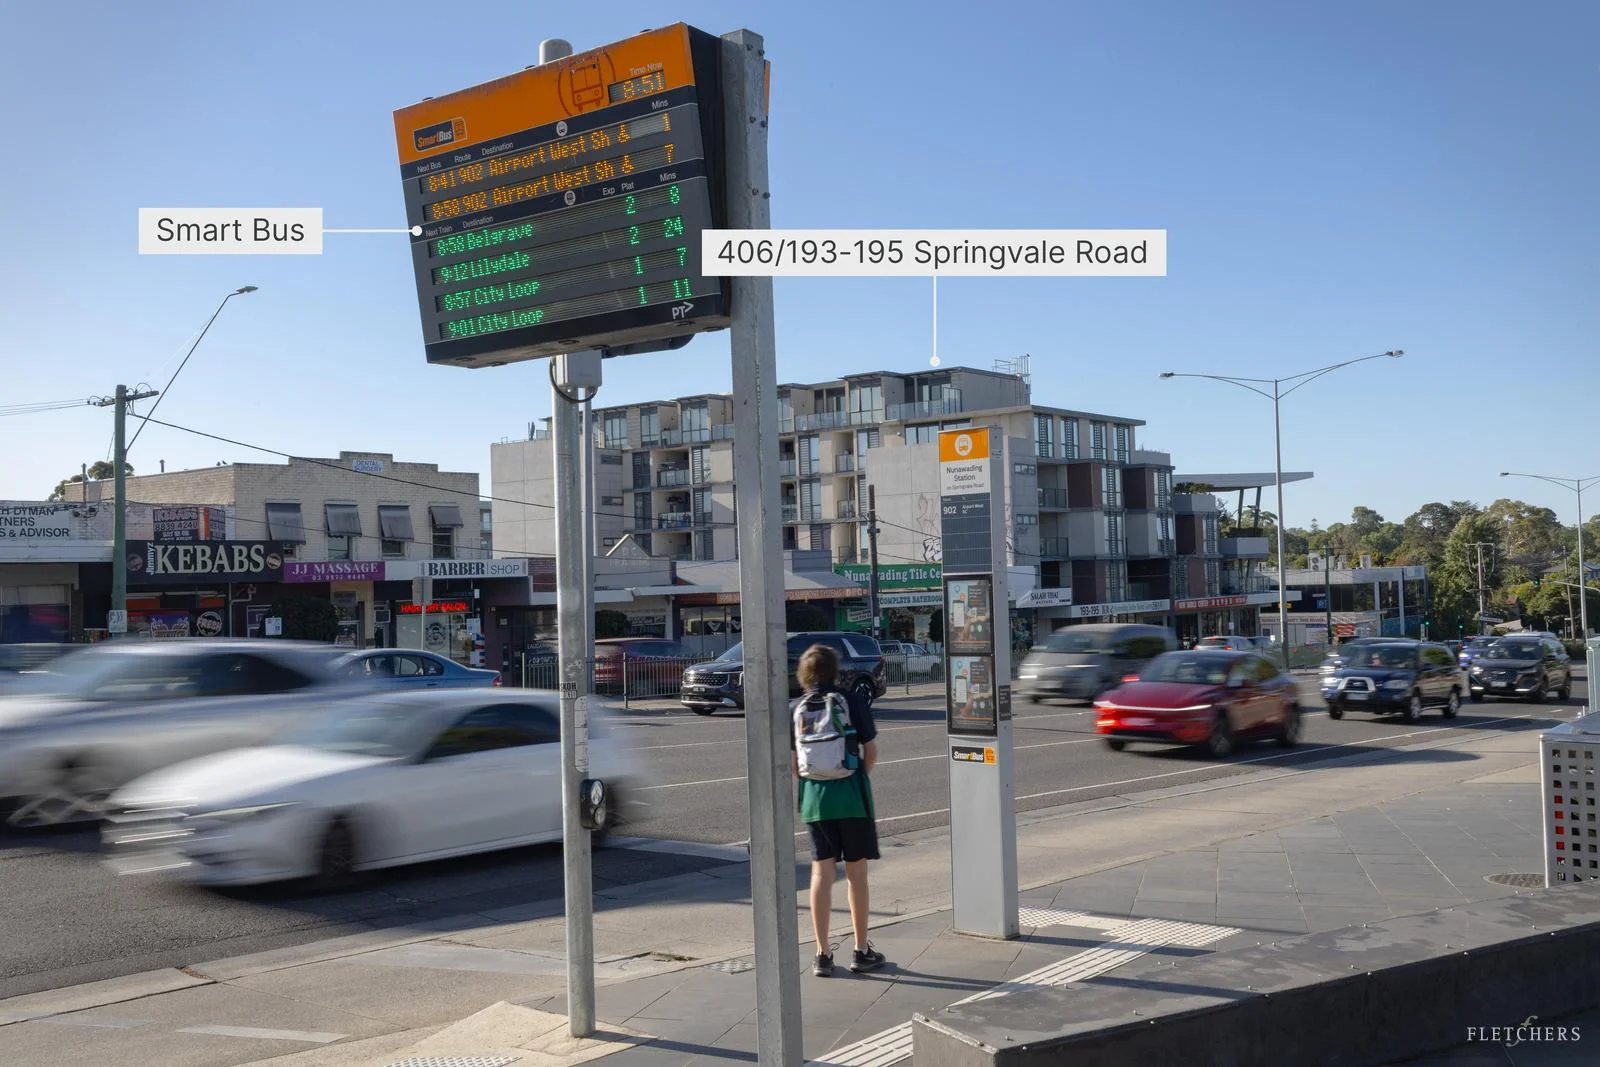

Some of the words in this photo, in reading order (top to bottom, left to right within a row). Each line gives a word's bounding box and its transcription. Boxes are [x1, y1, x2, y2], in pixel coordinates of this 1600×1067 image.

[630, 67, 646, 76] Time
[647, 62, 663, 71] Now
[623, 72, 664, 99] 8:51
[651, 99, 669, 110] Mins
[417, 163, 430, 173] Next
[431, 162, 442, 170] Bus
[454, 154, 472, 163] Route
[482, 142, 514, 156] Destination
[428, 170, 457, 192] 8:41
[458, 163, 484, 184] 902
[489, 144, 546, 176] Airport
[549, 135, 587, 161] West
[591, 130, 611, 150] Sh
[662, 111, 671, 133] 1
[432, 199, 460, 220] 8:58
[462, 191, 488, 212] 902
[493, 175, 550, 206] Airport
[553, 165, 591, 191] West
[595, 160, 615, 181] Sh
[664, 143, 674, 163] 7
[660, 172, 677, 182] Mins
[602, 186, 615, 196] Exp
[621, 181, 635, 191] Plat
[425, 229, 438, 237] Next
[439, 226, 453, 235] Train
[462, 215, 494, 228] Destination
[437, 235, 465, 256] 8:58
[466, 224, 534, 250] Belgrave
[626, 195, 636, 214] 2
[669, 185, 680, 204] 8
[441, 263, 469, 284] 9:12
[470, 251, 530, 278] Lilydale
[629, 226, 640, 245] 2
[664, 216, 684, 238] 24
[444, 290, 471, 311] 8:57
[474, 285, 504, 305] City
[507, 281, 540, 299] Loop
[634, 256, 644, 275] 1
[676, 247, 686, 266] 7
[448, 318, 476, 338] 9:01
[479, 313, 509, 333] City
[511, 310, 544, 326] Loop
[638, 286, 648, 304] 1
[673, 278, 692, 299] 11
[946, 464, 983, 474] Nunawading
[14, 506, 54, 516] DYMAN
[943, 506, 957, 514] 902
[9, 529, 16, 538] &
[19, 527, 70, 537] ADVISOR
[154, 544, 265, 574] KEBABS
[292, 564, 308, 574] JJ
[314, 563, 378, 574] MASSAGE
[428, 562, 485, 576] BARBER
[491, 564, 519, 575] SHOP
[845, 569, 907, 583] Nunaading
[909, 568, 927, 580] Tile
[880, 596, 910, 604] COMPLETE
[1080, 606, 1099, 616] 193-195
[953, 750, 984, 761] SmartBus
